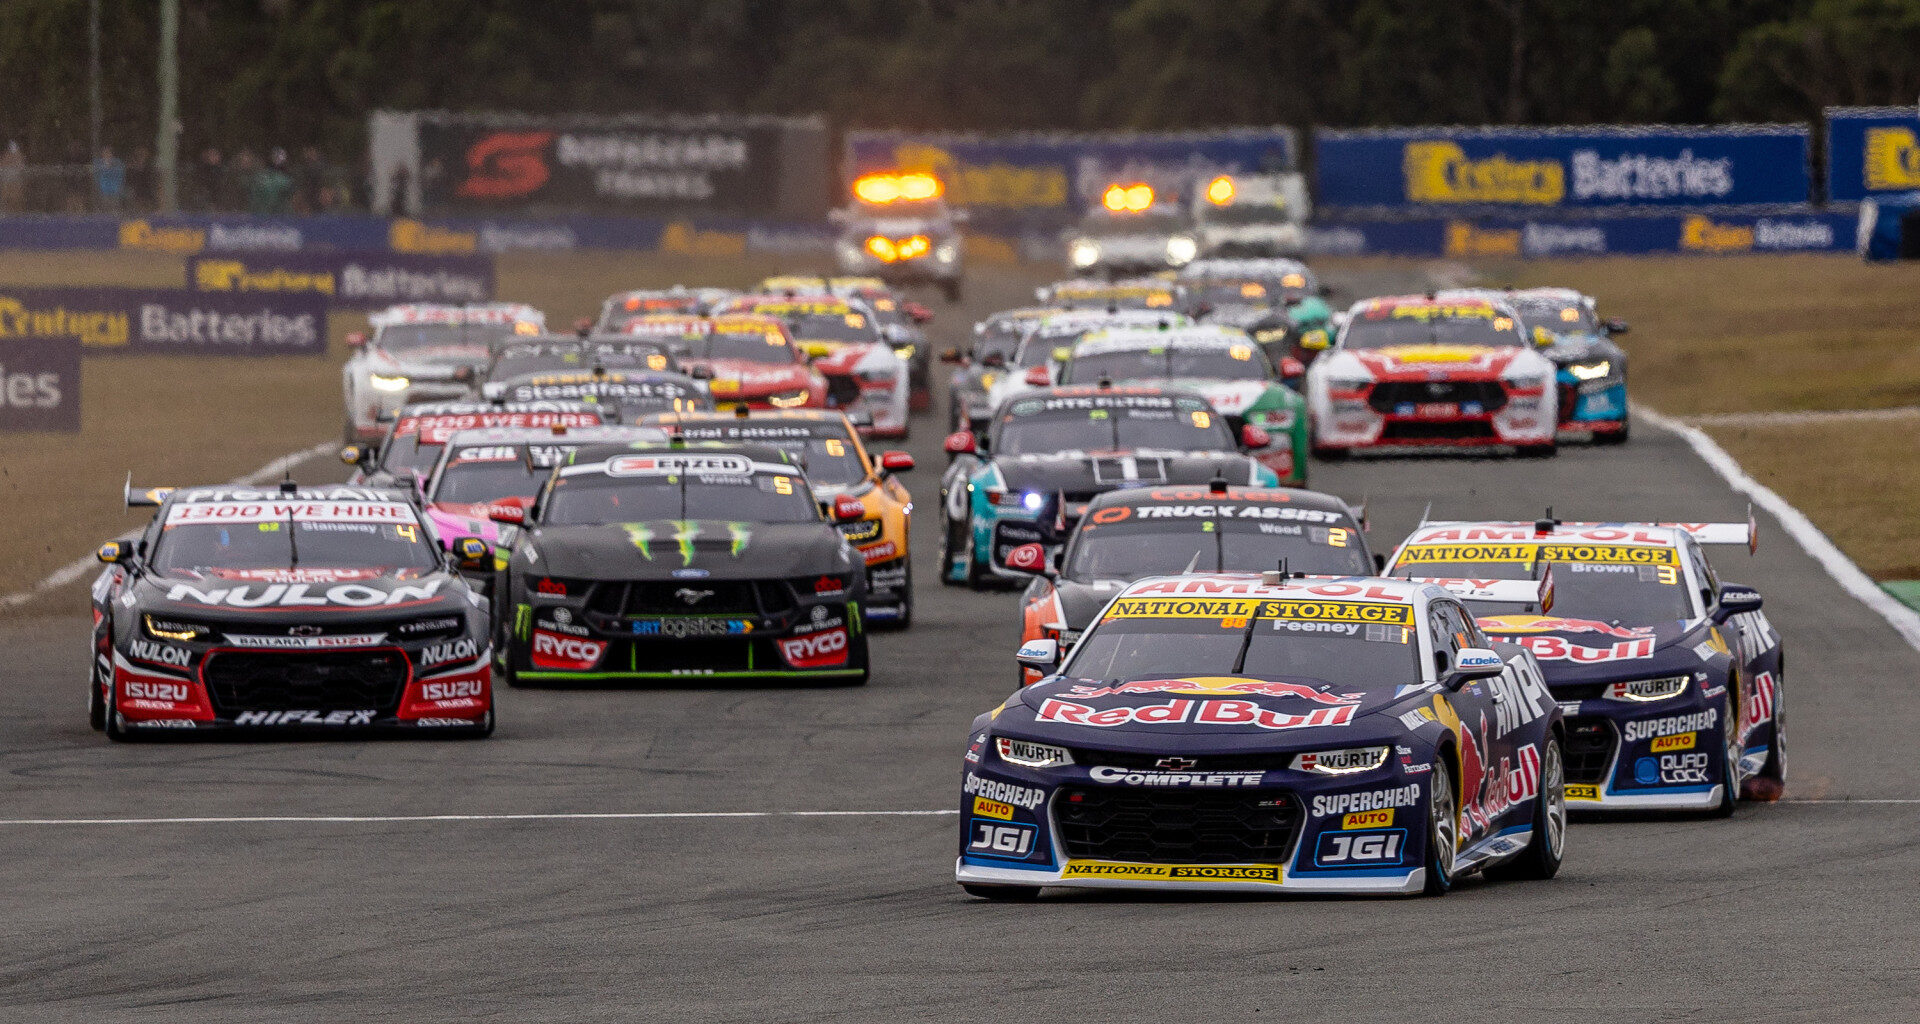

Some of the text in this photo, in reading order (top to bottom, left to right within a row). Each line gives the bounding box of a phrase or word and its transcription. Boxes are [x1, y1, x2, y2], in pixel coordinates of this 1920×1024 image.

[1572, 148, 1733, 198] Batteries
[139, 303, 316, 345] Batteries
[825, 438, 845, 457] 6
[657, 459, 739, 471] ENZED
[774, 475, 793, 496] 5
[173, 504, 408, 520] 1300 WE HIRE
[1136, 504, 1343, 524] TRUCK ASSIST
[301, 520, 378, 534] Stanaway
[396, 523, 417, 544] 4
[1258, 522, 1303, 536] Wood
[1327, 527, 1348, 548] 2
[1403, 545, 1668, 564] NATIONAL STORAGE
[1570, 562, 1635, 575] Brown
[1657, 564, 1678, 586] 3
[167, 581, 442, 608] NULON
[1130, 580, 1405, 602] AMPOL
[1114, 601, 1403, 622] NATIONAL STORAGE
[1273, 618, 1360, 636] Feeney
[317, 636, 372, 646] ISUZU
[534, 632, 602, 663] RYCO
[783, 629, 847, 661] RYCO
[1515, 635, 1657, 664] Bull
[128, 640, 193, 668] NULON
[421, 637, 479, 667] NULON
[125, 681, 189, 701] ISUZU
[422, 680, 483, 701] ISUZU
[235, 709, 377, 726] HIFLEX
[1035, 697, 1361, 730] Red Bull
[1624, 707, 1718, 743] SUPERCHEAP
[1012, 741, 1065, 763] WÜRTH
[1656, 736, 1691, 749] AUTO
[1319, 750, 1382, 768] WÜRTH
[1660, 753, 1709, 771] QUAD
[1089, 765, 1263, 786] COMPLETE
[1660, 767, 1710, 783] LOCK
[964, 771, 1046, 811] SUPERCHEAP
[1312, 783, 1421, 818] SUPERCHEAP
[977, 801, 1010, 816] AUTO
[1347, 813, 1389, 826] AUTO
[971, 824, 1033, 854] JGI
[1321, 834, 1401, 863] JGI
[1065, 864, 1275, 879] NATIONAL STORAGE
